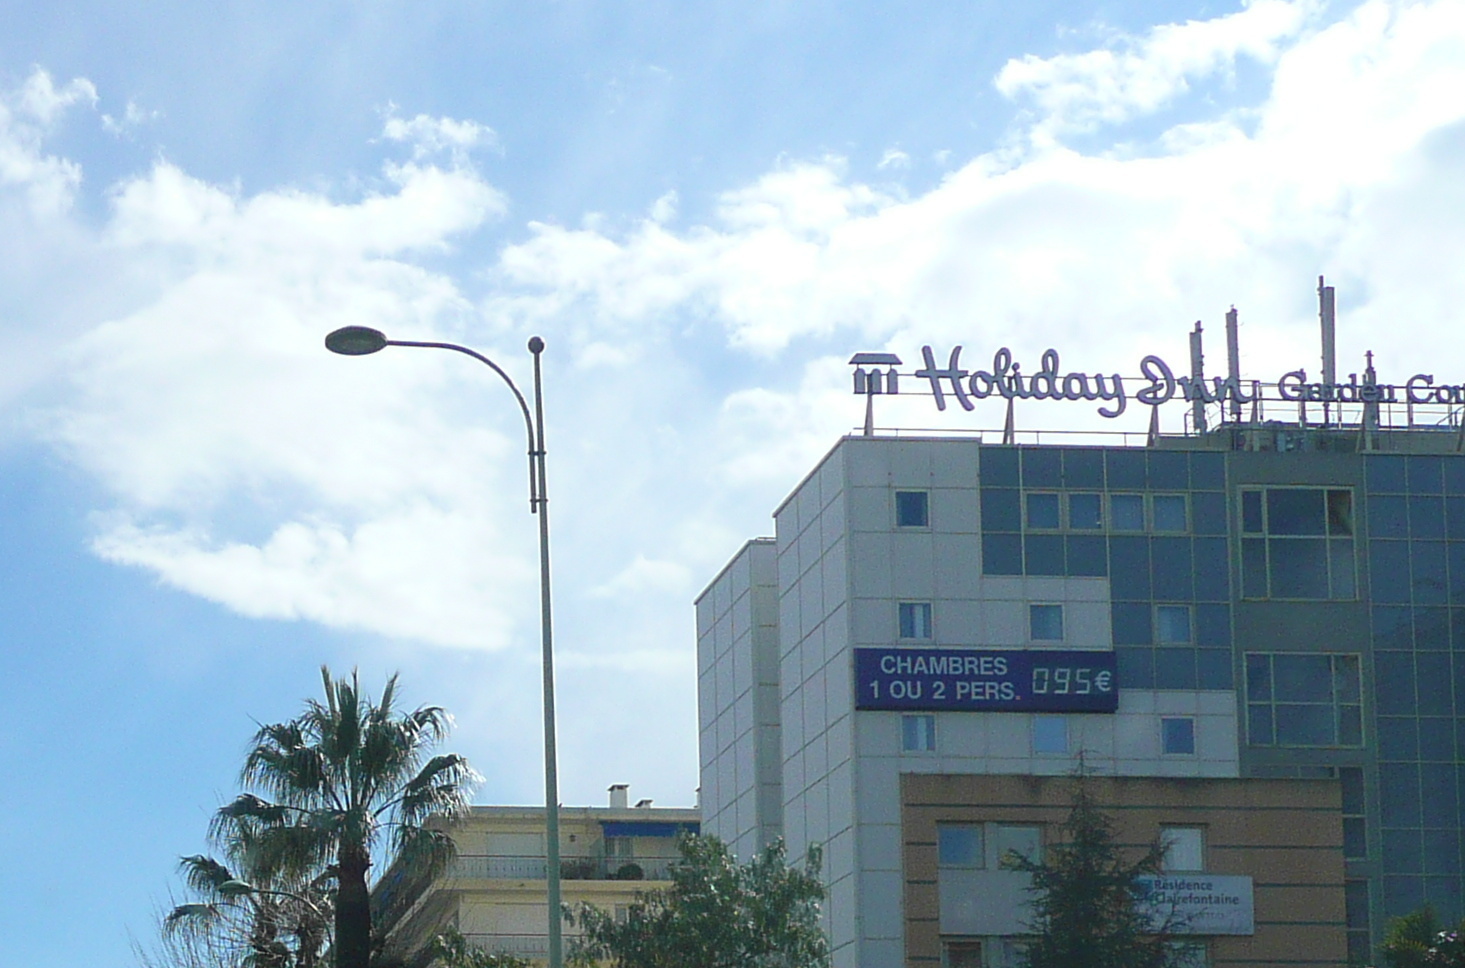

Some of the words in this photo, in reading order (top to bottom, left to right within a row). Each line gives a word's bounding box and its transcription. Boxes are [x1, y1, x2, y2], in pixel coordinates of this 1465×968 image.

[915, 345, 1127, 418] Holiday
[1136, 355, 1258, 405] Inn
[880, 655, 1008, 675] CHAMBRES
[869, 680, 879, 698] 1
[889, 680, 922, 699] OU
[932, 681, 946, 699] 2
[956, 681, 1021, 700] PERS.
